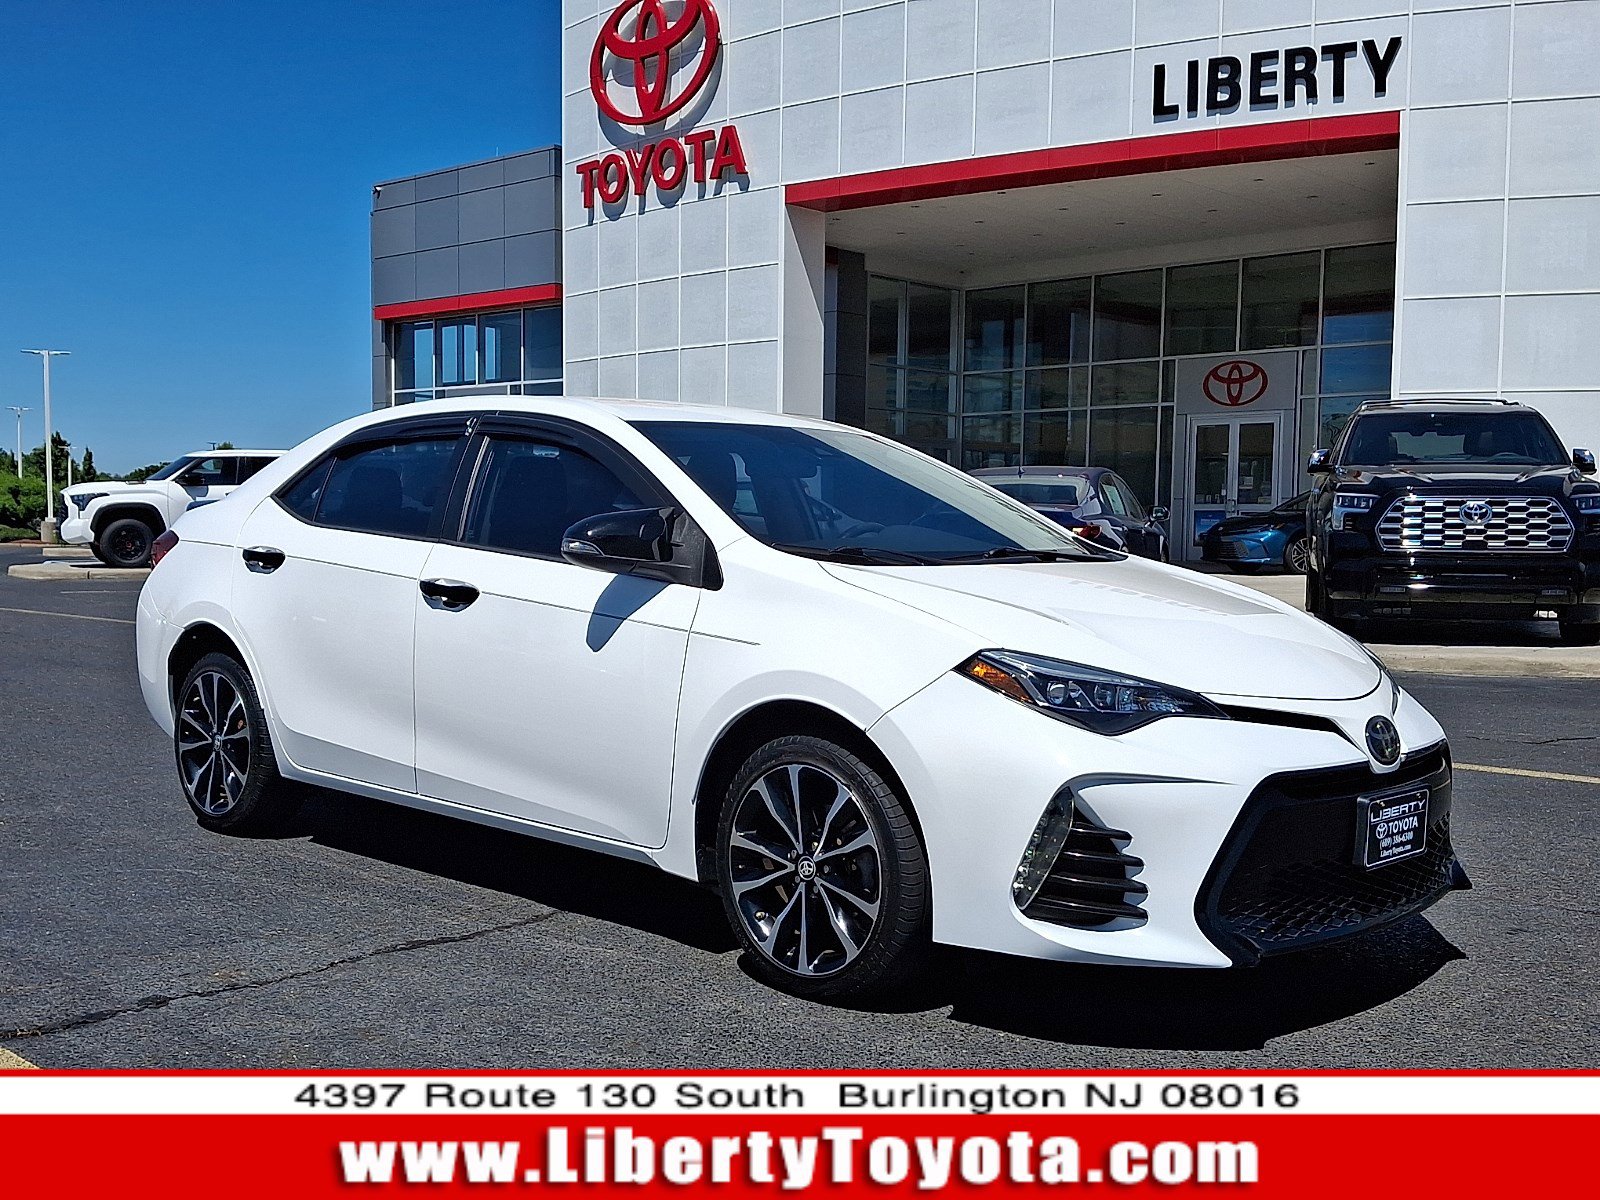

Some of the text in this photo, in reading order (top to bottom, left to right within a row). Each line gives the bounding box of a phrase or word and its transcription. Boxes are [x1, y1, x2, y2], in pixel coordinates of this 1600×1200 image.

[1153, 36, 1402, 119] LIBERTY
[576, 125, 748, 209] TOYOTA
[1370, 799, 1425, 822] LIBERTY
[1388, 816, 1418, 834] TOYOTA
